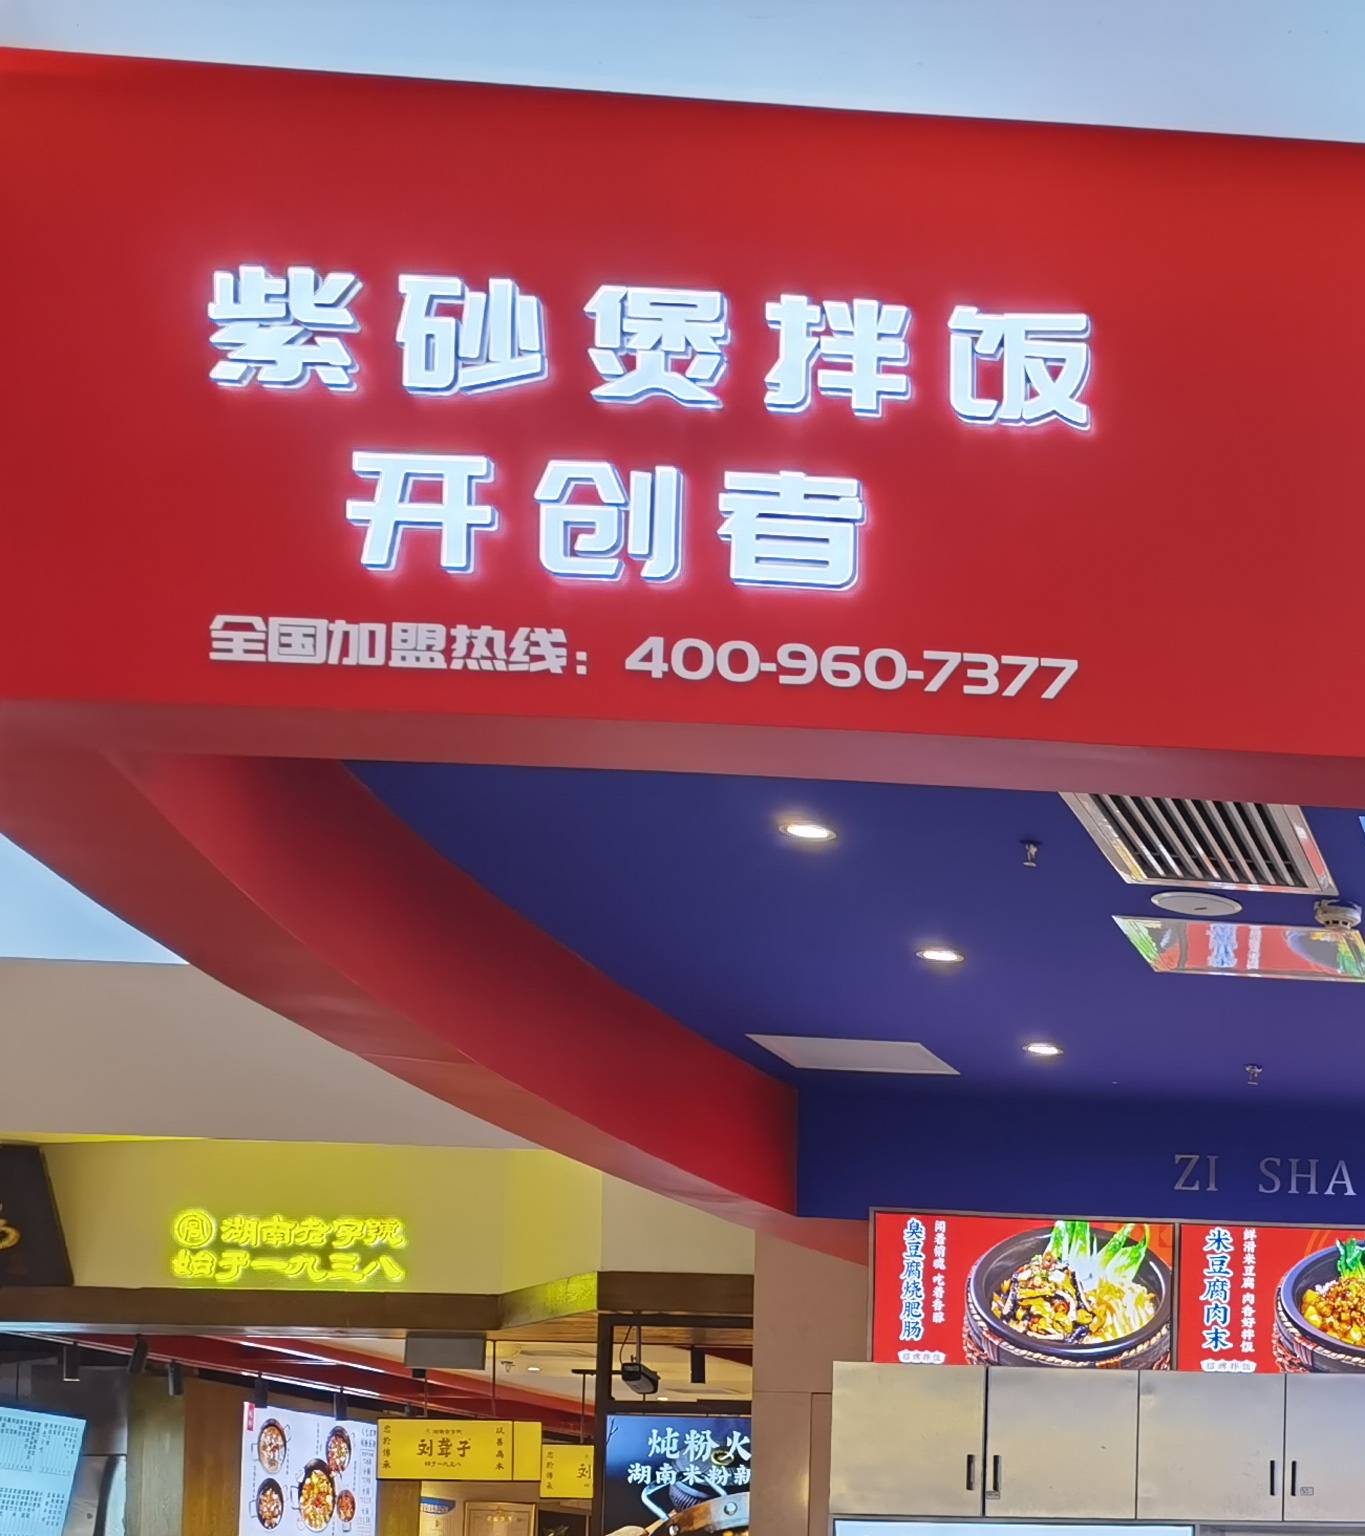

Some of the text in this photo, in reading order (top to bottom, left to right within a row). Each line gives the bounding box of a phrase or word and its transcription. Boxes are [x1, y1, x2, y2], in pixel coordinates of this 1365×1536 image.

[207, 264, 1093, 430] 紫砂煲拌饭
[346, 450, 866, 592] 开创者
[624, 634, 1081, 701] 400-960-7377
[1173, 1153, 1219, 1193] ZI
[1257, 1155, 1357, 1196] SHA
[899, 1218, 926, 1341] 臭豆腐烧肥肠
[1200, 1227, 1235, 1353] 米豆腐肉末
